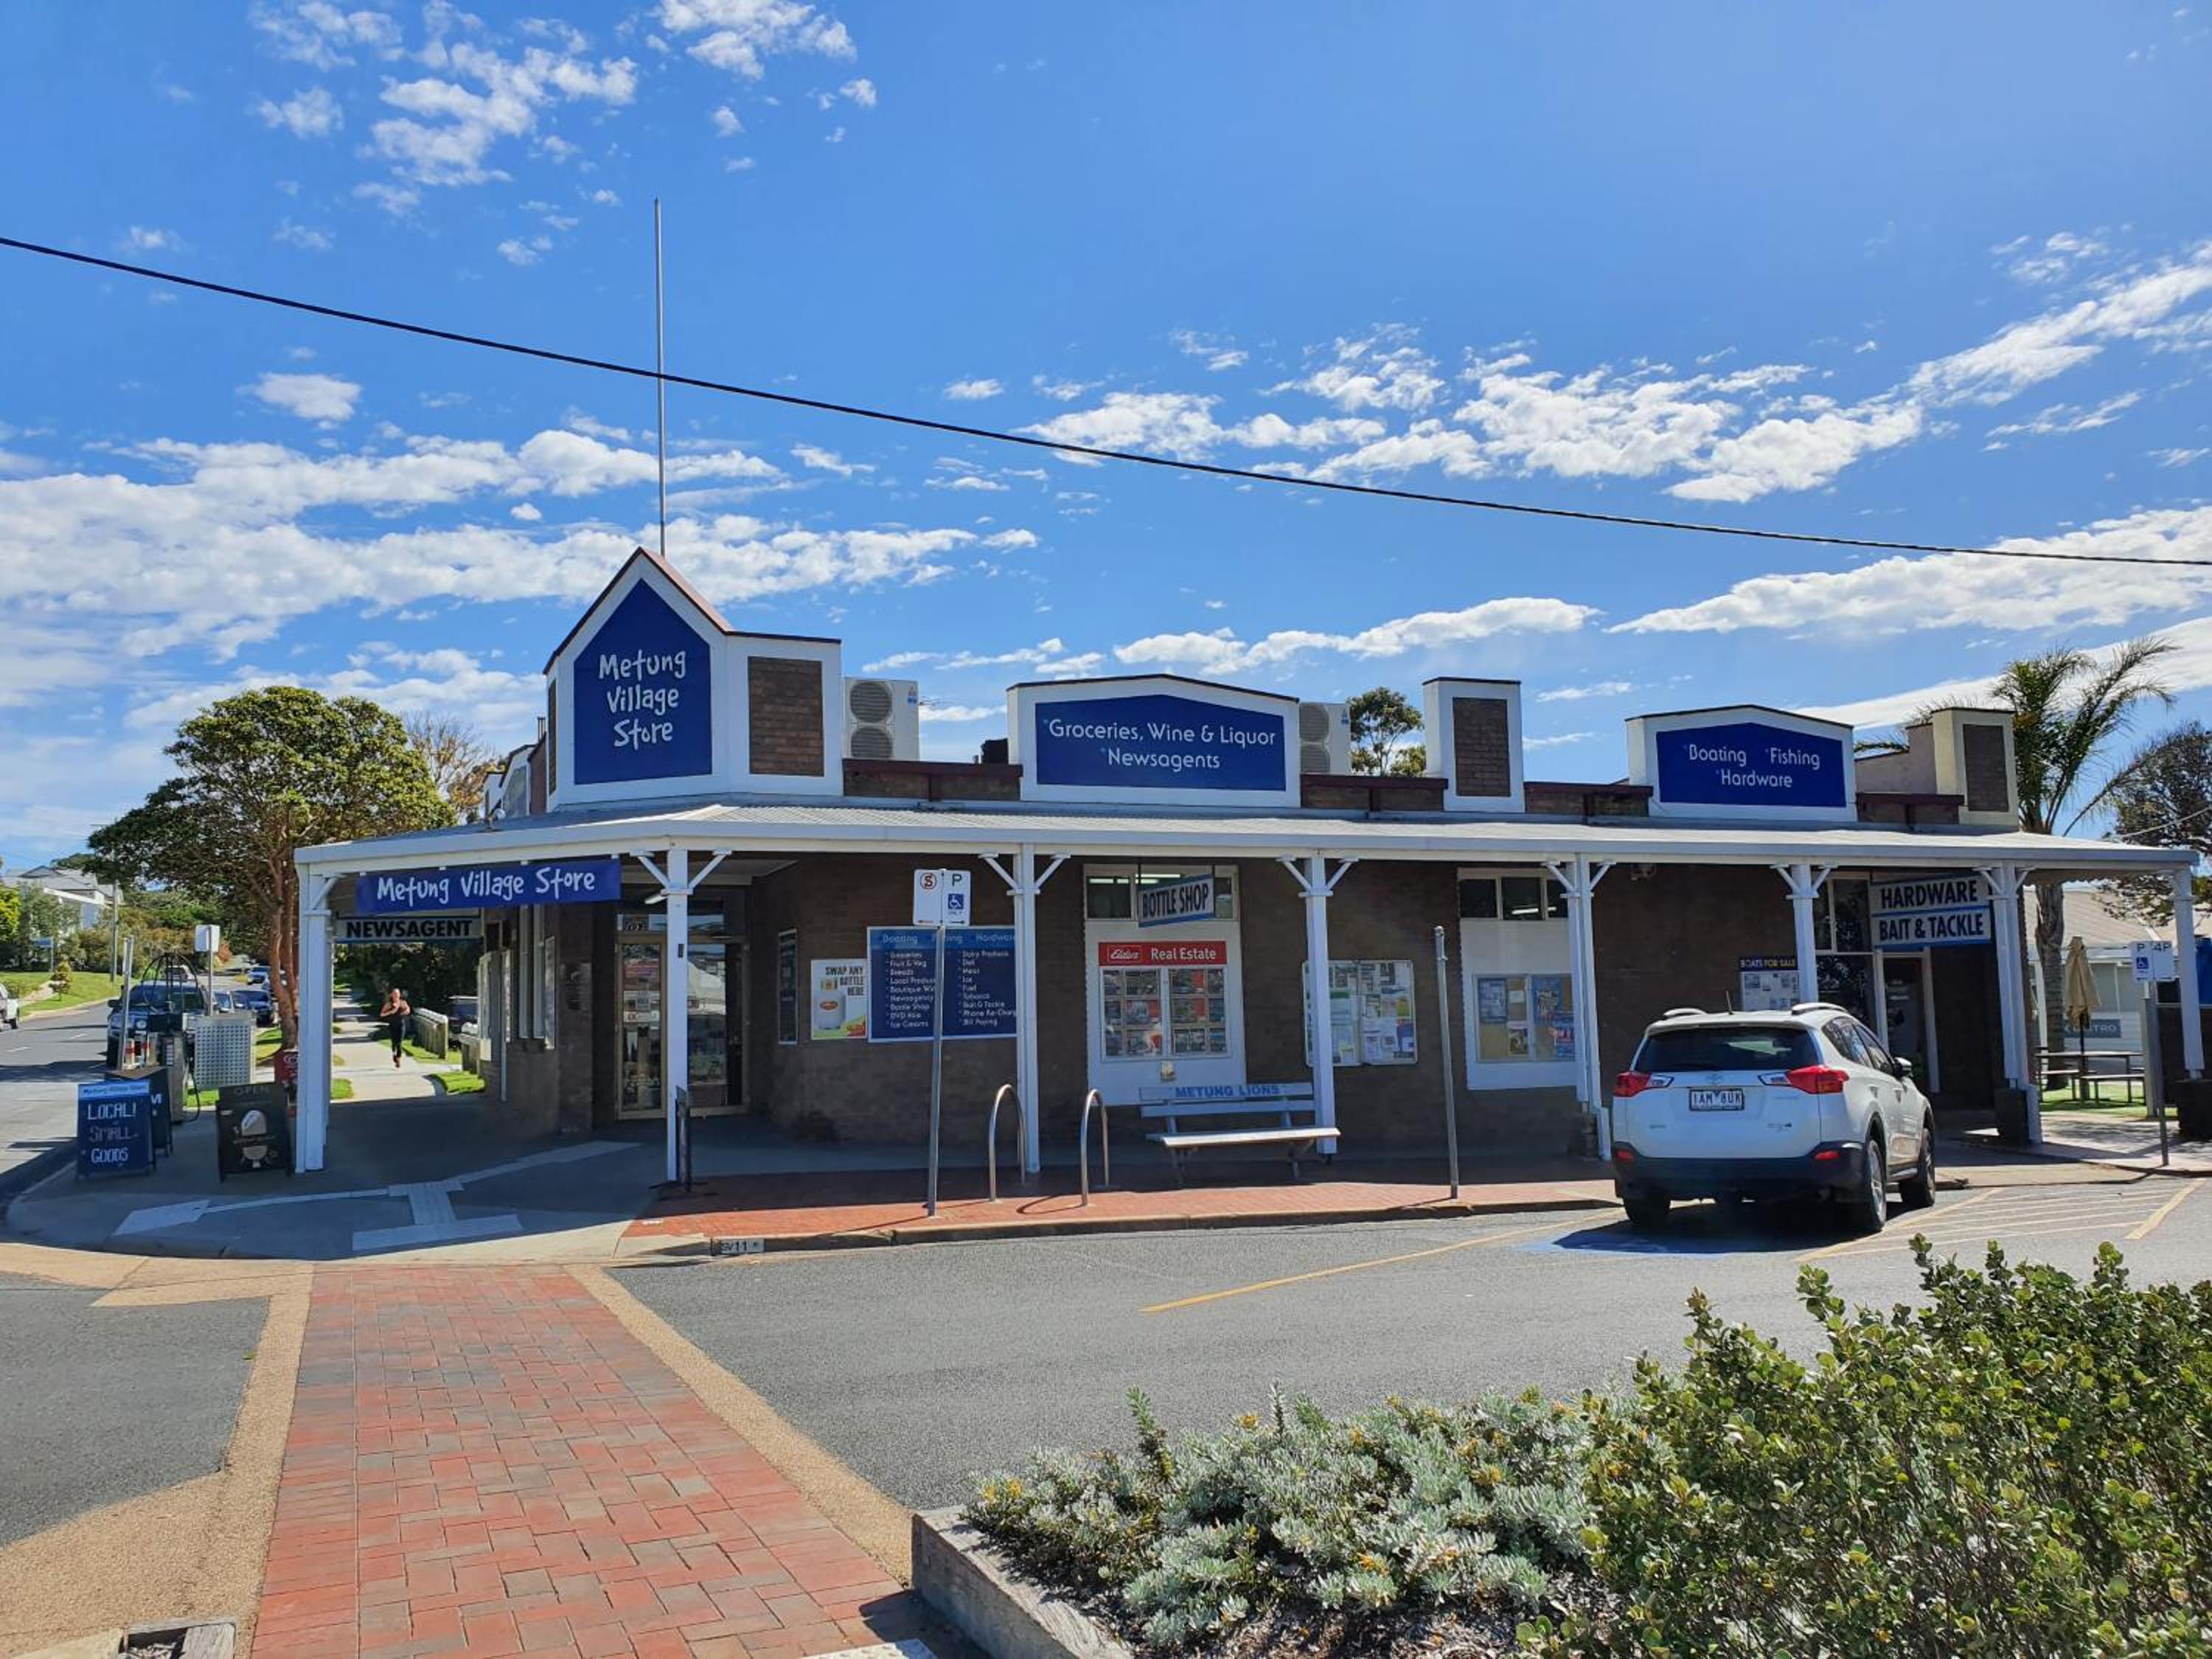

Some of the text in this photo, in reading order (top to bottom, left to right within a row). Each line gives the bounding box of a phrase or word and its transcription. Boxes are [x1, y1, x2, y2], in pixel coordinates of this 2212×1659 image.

[599, 650, 686, 681] Metung
[607, 684, 679, 716] Village
[614, 718, 673, 750] Store
[1049, 719, 1276, 748] Groceries, Wine & Liquor
[1108, 748, 1220, 772] Newsagents
[1689, 744, 1820, 770] Boating Fishing
[1722, 768, 1793, 787] Hardware
[377, 867, 595, 907] Metung Village Store
[952, 874, 962, 886] P
[1143, 883, 1208, 919] BOTTLE SHOP
[1882, 880, 1978, 908] HARDWARE
[346, 919, 473, 939] NEWSAGENT
[1879, 914, 1983, 941] BAIT & TACKLE
[883, 933, 918, 945] Boating
[2138, 943, 2145, 952] P
[2152, 943, 2171, 952] 4P
[1151, 947, 1177, 959] Real
[1180, 947, 1217, 959] Estate
[826, 966, 863, 975] SWAP ANY
[840, 976, 864, 985] BOTTLE
[1175, 1085, 1280, 1098] METUNG LIONS
[91, 1147, 128, 1163] GOODS
